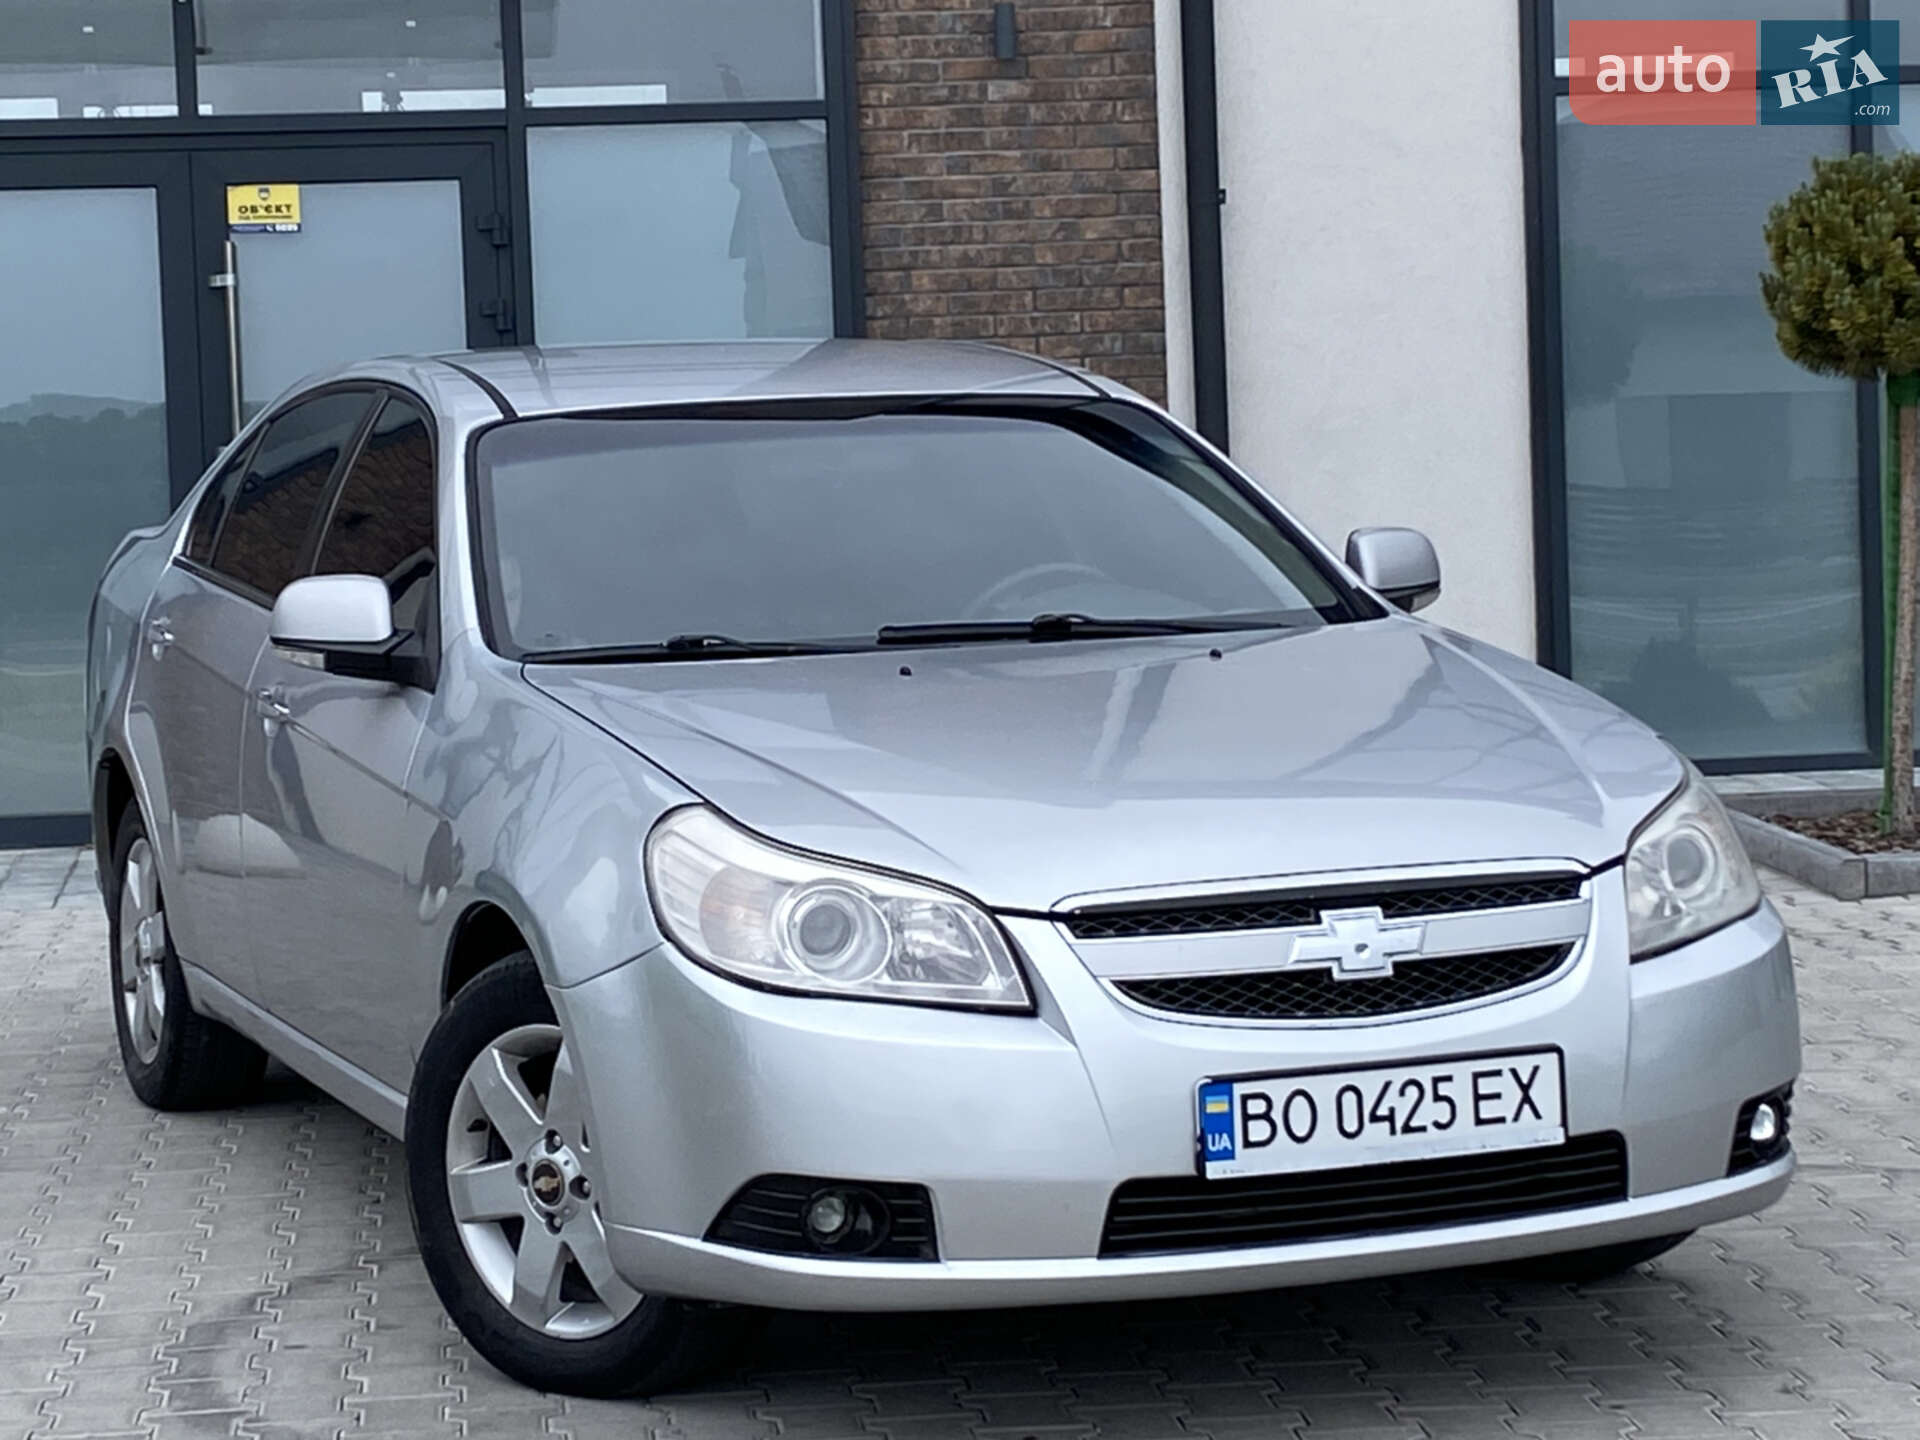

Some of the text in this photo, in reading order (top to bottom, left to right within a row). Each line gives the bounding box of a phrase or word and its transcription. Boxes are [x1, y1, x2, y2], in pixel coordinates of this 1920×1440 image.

[1239, 1065, 1543, 1150] BO 0425 EX
[1207, 1132, 1232, 1152] UA
